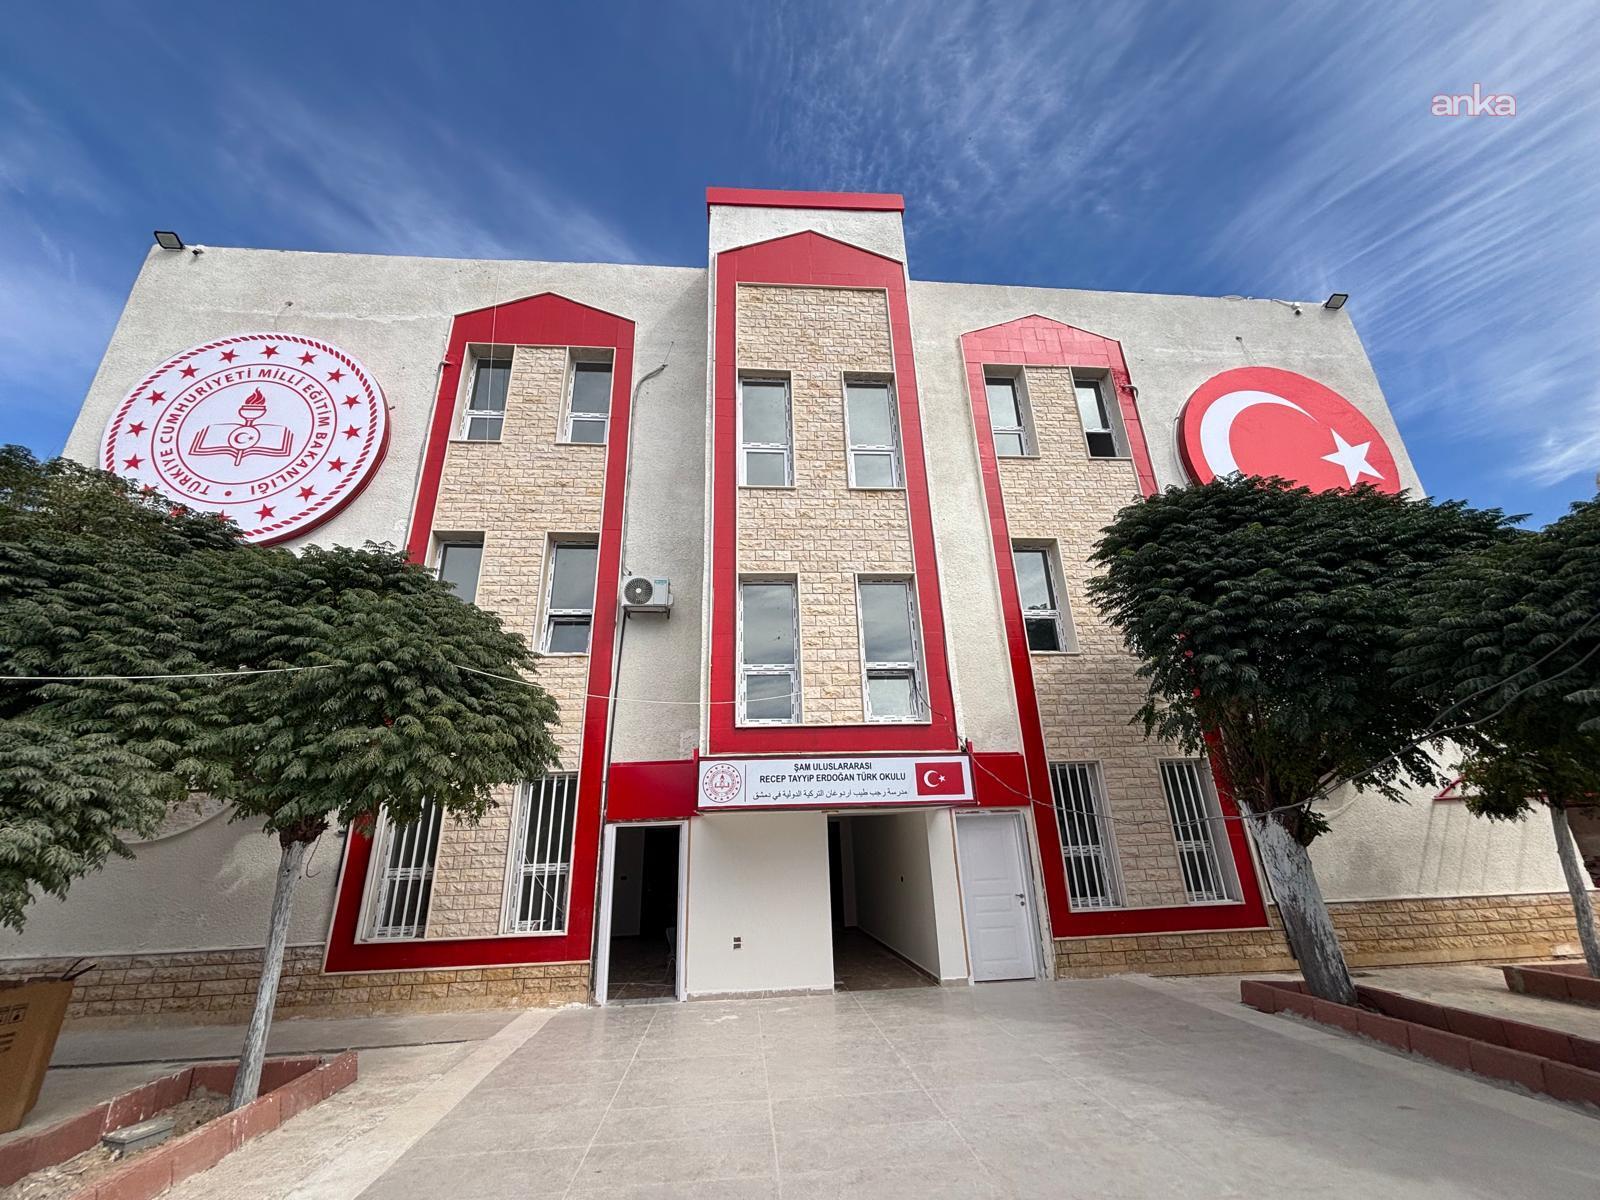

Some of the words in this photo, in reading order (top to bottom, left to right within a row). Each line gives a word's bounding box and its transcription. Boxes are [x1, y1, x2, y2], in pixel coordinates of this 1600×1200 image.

[258, 369, 306, 386] MİLLİ
[160, 368, 251, 443] CUMHURİYETİ
[302, 383, 332, 427] EĞİTİM
[251, 432, 328, 495] BAKANLIĞI
[160, 448, 210, 495] TÜRKİYE
[794, 763, 811, 773] ŞAM
[813, 762, 872, 771] ULUSLARARASI
[760, 774, 786, 783] RECEP
[816, 772, 855, 782] ERDOĞAN
[857, 771, 878, 781] TÜRK
[880, 772, 906, 781] OKULU
[753, 791, 771, 801] دمشق
[772, 791, 781, 801] في
[782, 790, 802, 799] الدولية
[803, 789, 825, 799] التركية
[853, 788, 869, 797] طيب
[887, 788, 908, 797] مدرسة
